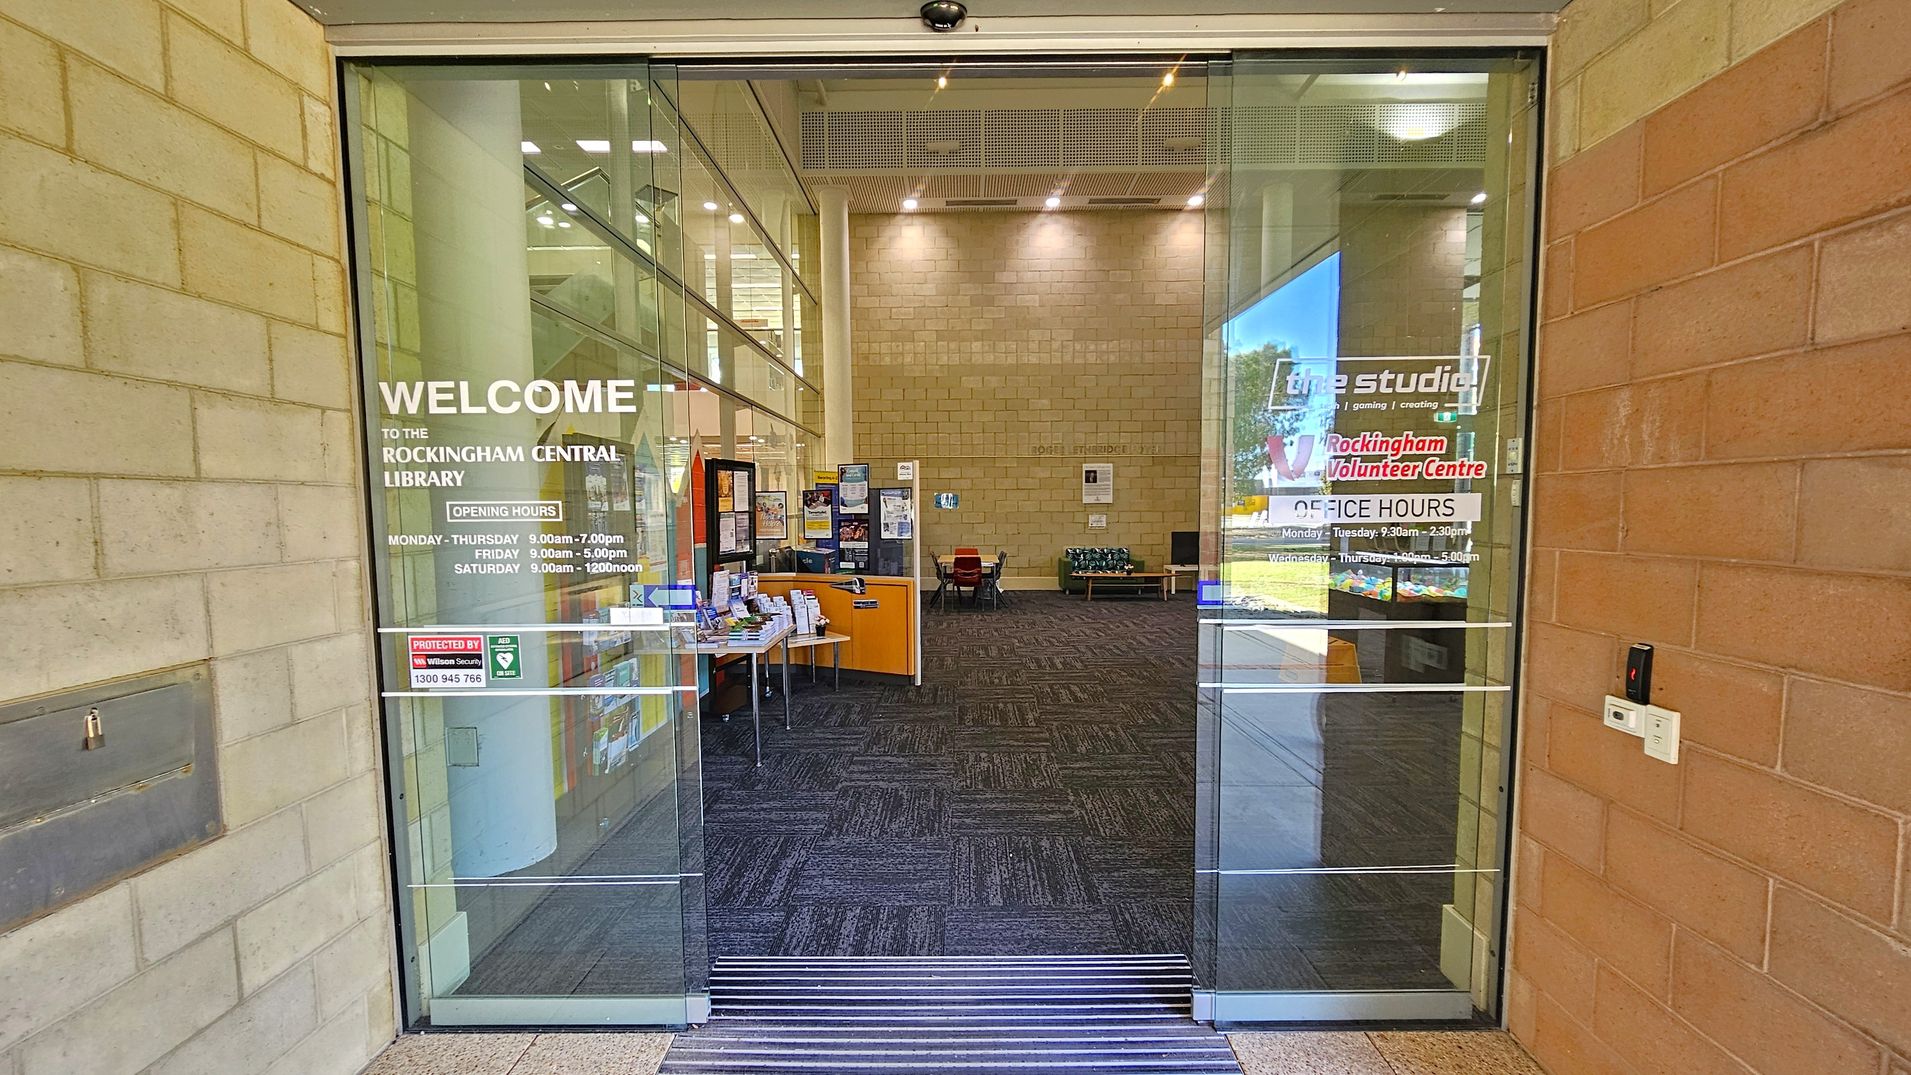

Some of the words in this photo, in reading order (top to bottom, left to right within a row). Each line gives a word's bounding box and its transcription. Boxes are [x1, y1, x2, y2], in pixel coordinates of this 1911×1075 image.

[1286, 368, 1348, 394] the
[1353, 366, 1472, 394] studio
[379, 379, 637, 414] WELCOME
[1352, 401, 1388, 410] gaming
[1400, 400, 1439, 410] creating
[381, 428, 399, 440] TO
[403, 428, 429, 439] THE
[1326, 432, 1446, 458] Rockingham
[383, 445, 524, 464] ROCKINGHAM
[531, 445, 621, 462] CENTRAL
[1326, 458, 1421, 480] Volunteer
[1424, 457, 1487, 478] Centre
[384, 470, 465, 488] LIBRARY
[452, 506, 509, 518] OPENING
[512, 505, 557, 517] HOURS
[1294, 499, 1370, 519] OFFICE
[1379, 498, 1455, 518] HOURS
[1282, 528, 1322, 540] Monday
[1332, 527, 1378, 540] Tuesday:
[1381, 527, 1418, 537] 9:30am
[1429, 526, 1468, 538] 2:30pm
[388, 535, 442, 546] MONDAY
[451, 534, 519, 545] THURSDAY
[475, 549, 519, 560] FRIDAY
[530, 548, 573, 559] 9.00am
[583, 548, 627, 562] 5.00pm
[1268, 553, 1329, 565] Wednesday
[1338, 552, 1390, 564] Thursday:
[454, 563, 520, 574] SATURDAY
[530, 563, 574, 574] 9.00am
[585, 562, 643, 573] 1200noon
[413, 640, 464, 650] PROTECTED
[467, 640, 479, 649] BY
[456, 658, 482, 666] Security
[415, 674, 438, 683] 1300
[442, 674, 460, 683] 945
[464, 674, 482, 683] 766
